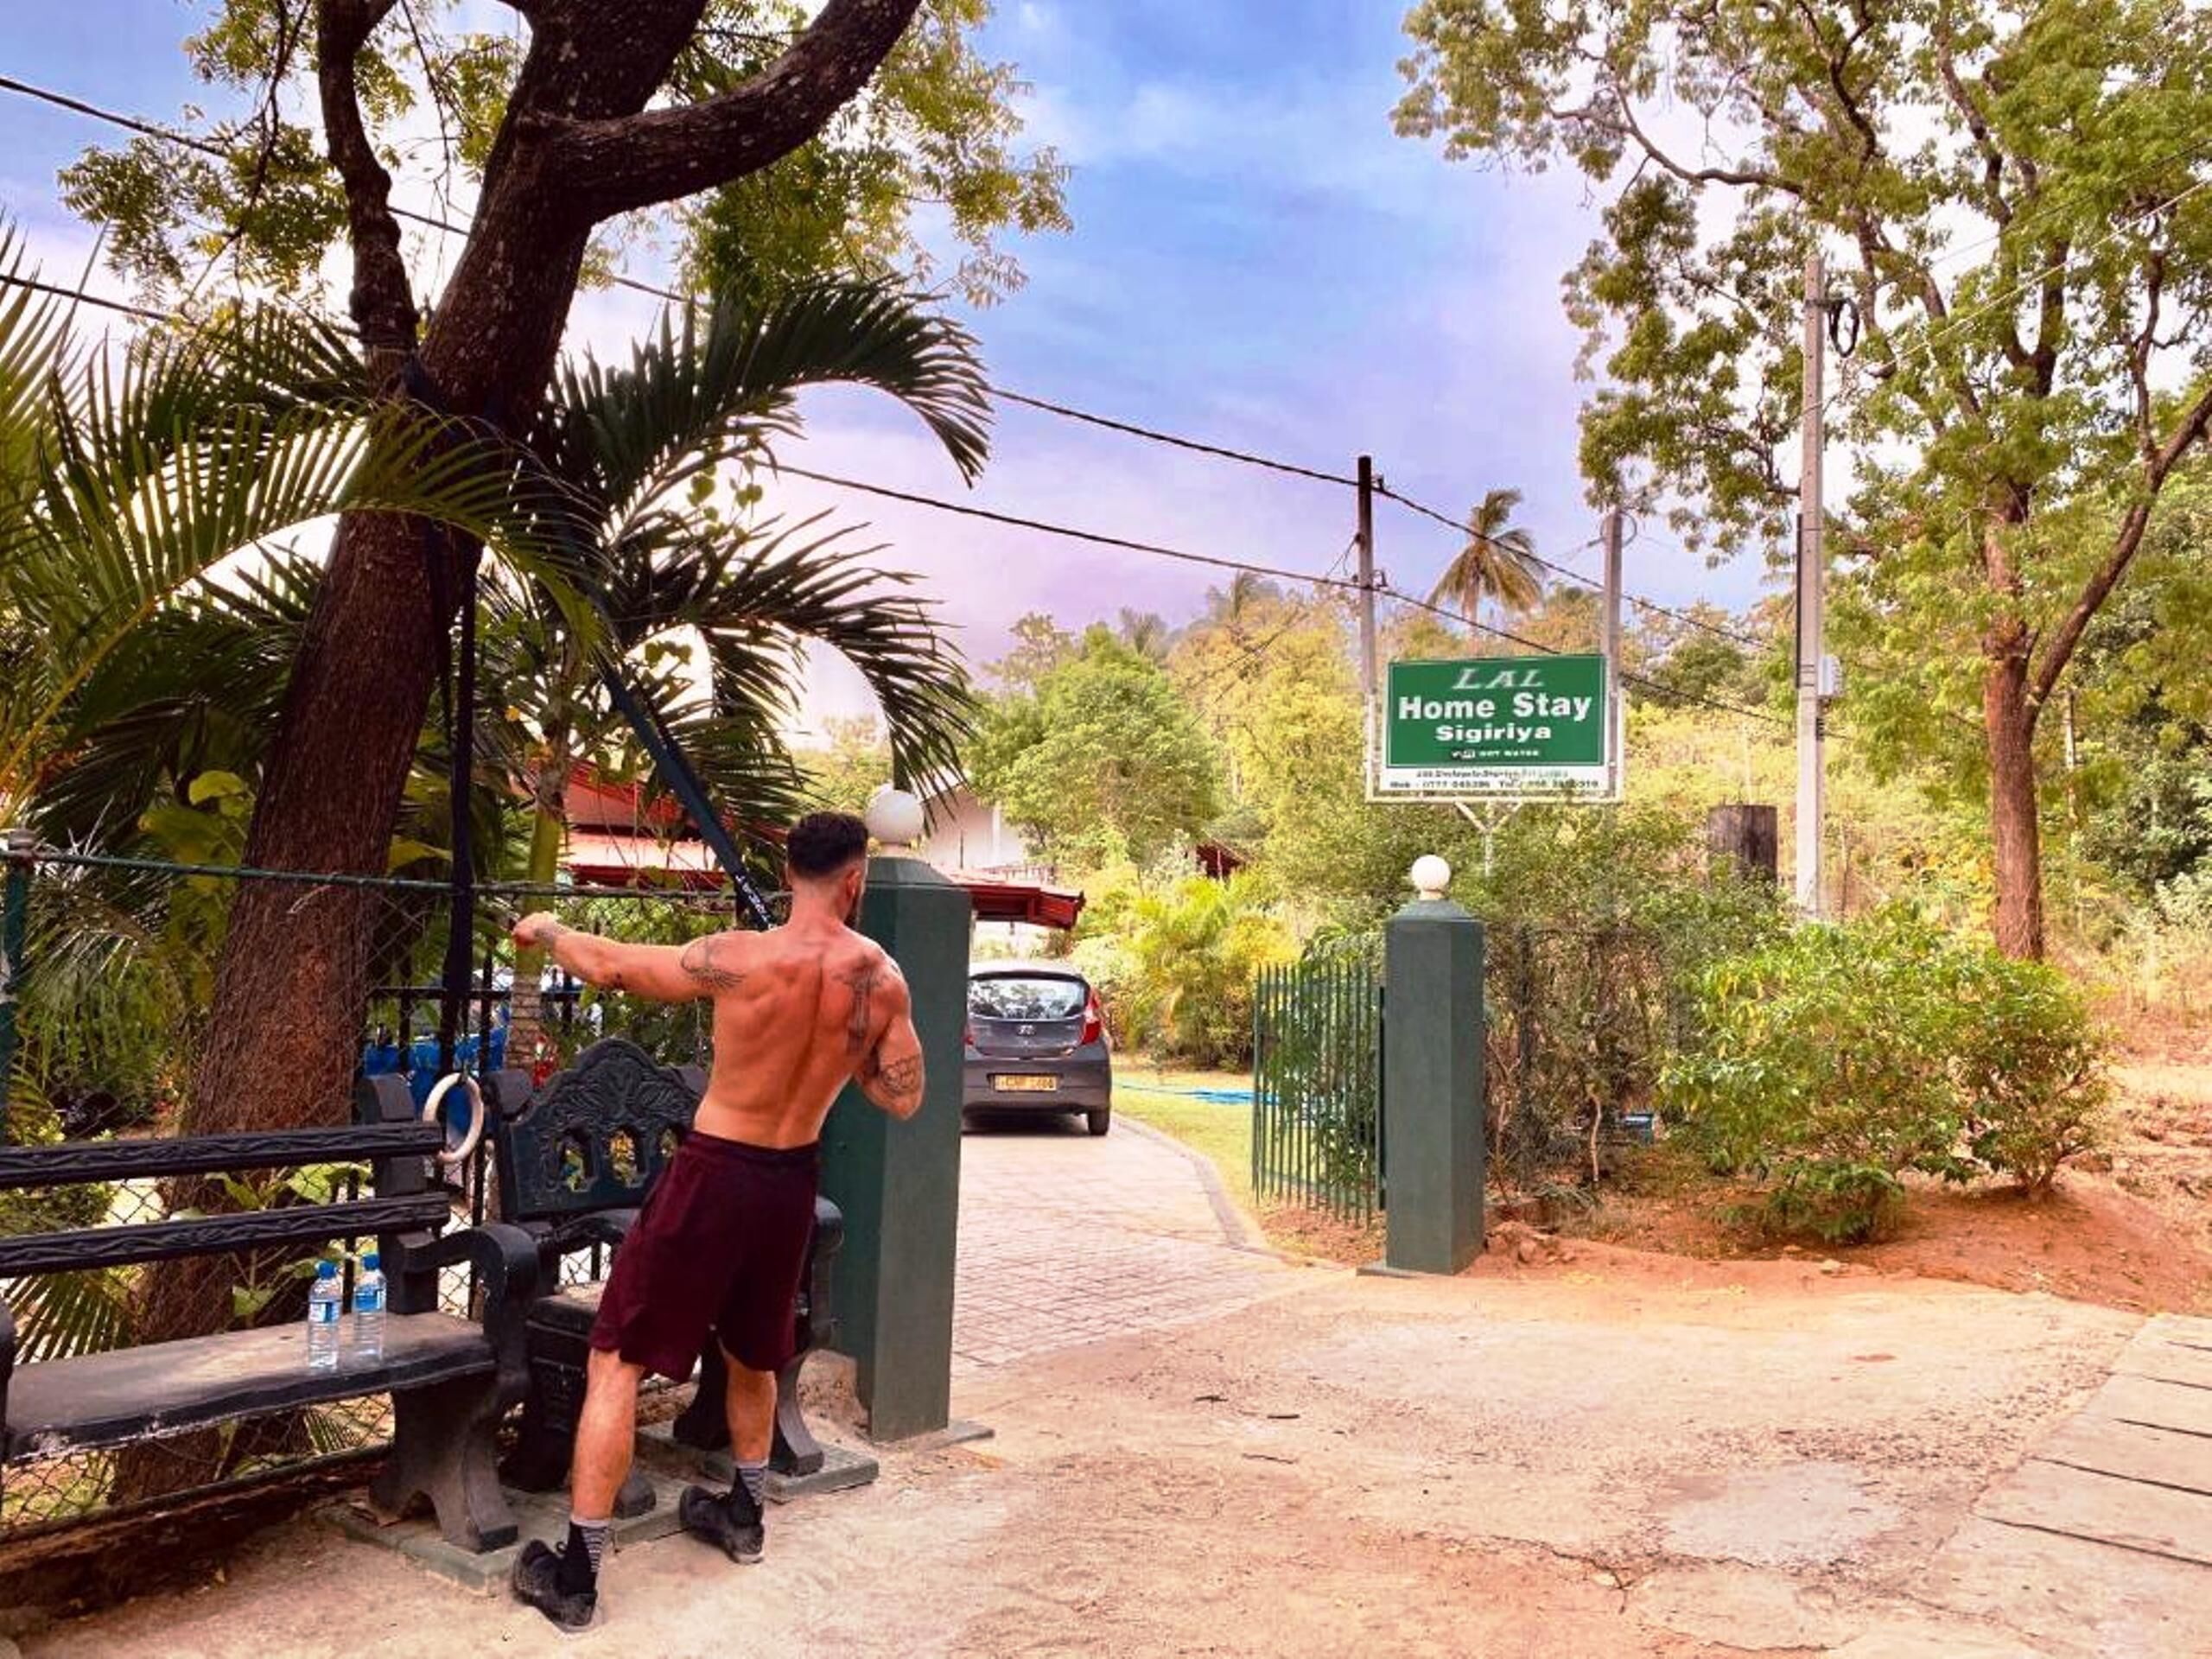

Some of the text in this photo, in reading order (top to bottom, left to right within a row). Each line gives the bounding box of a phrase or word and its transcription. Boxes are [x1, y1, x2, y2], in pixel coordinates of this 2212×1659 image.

[1452, 668, 1545, 690] LAL
[1398, 692, 1592, 721] Home Stay
[1435, 723, 1552, 743] Sigiriya
